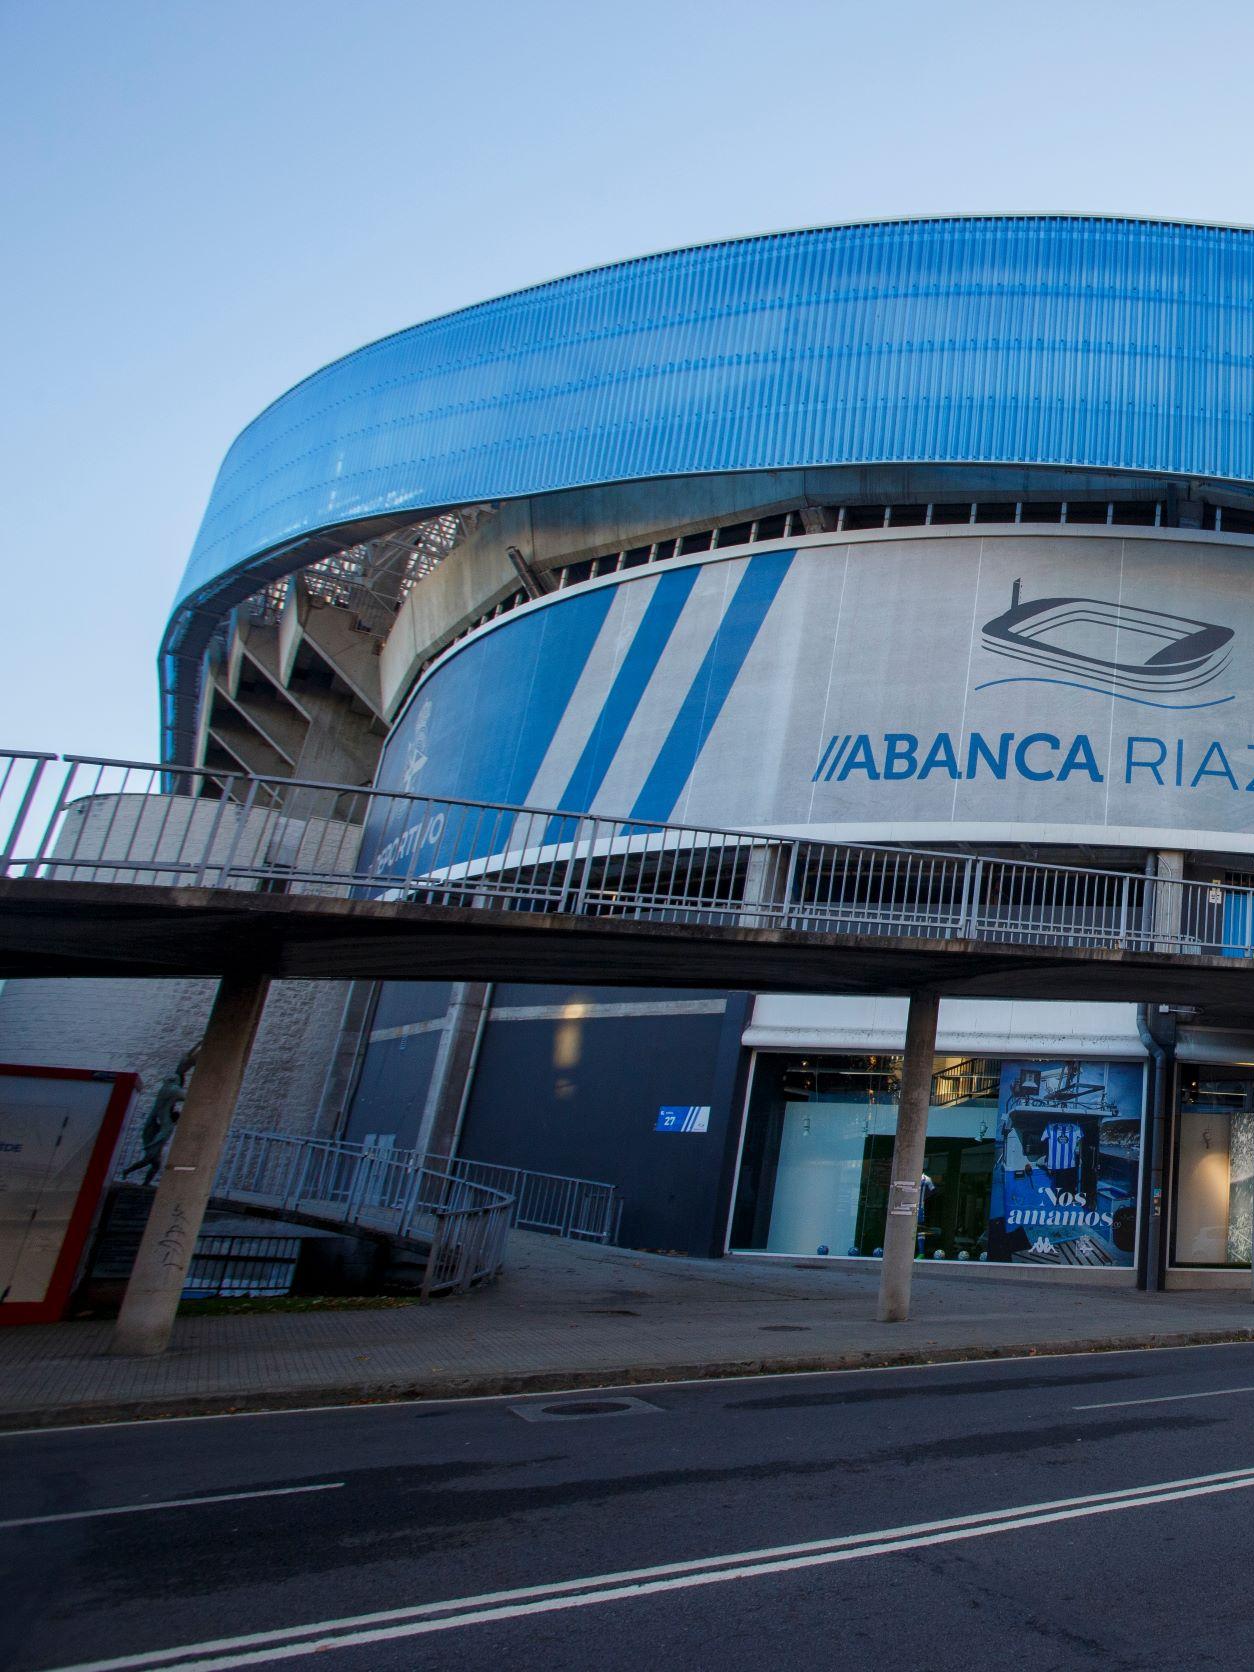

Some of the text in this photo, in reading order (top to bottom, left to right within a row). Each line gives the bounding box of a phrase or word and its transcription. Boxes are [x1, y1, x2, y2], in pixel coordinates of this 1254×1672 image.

[664, 1116, 676, 1126] 27
[1037, 1187, 1087, 1207] Nos
[1007, 1209, 1114, 1227] amamos
